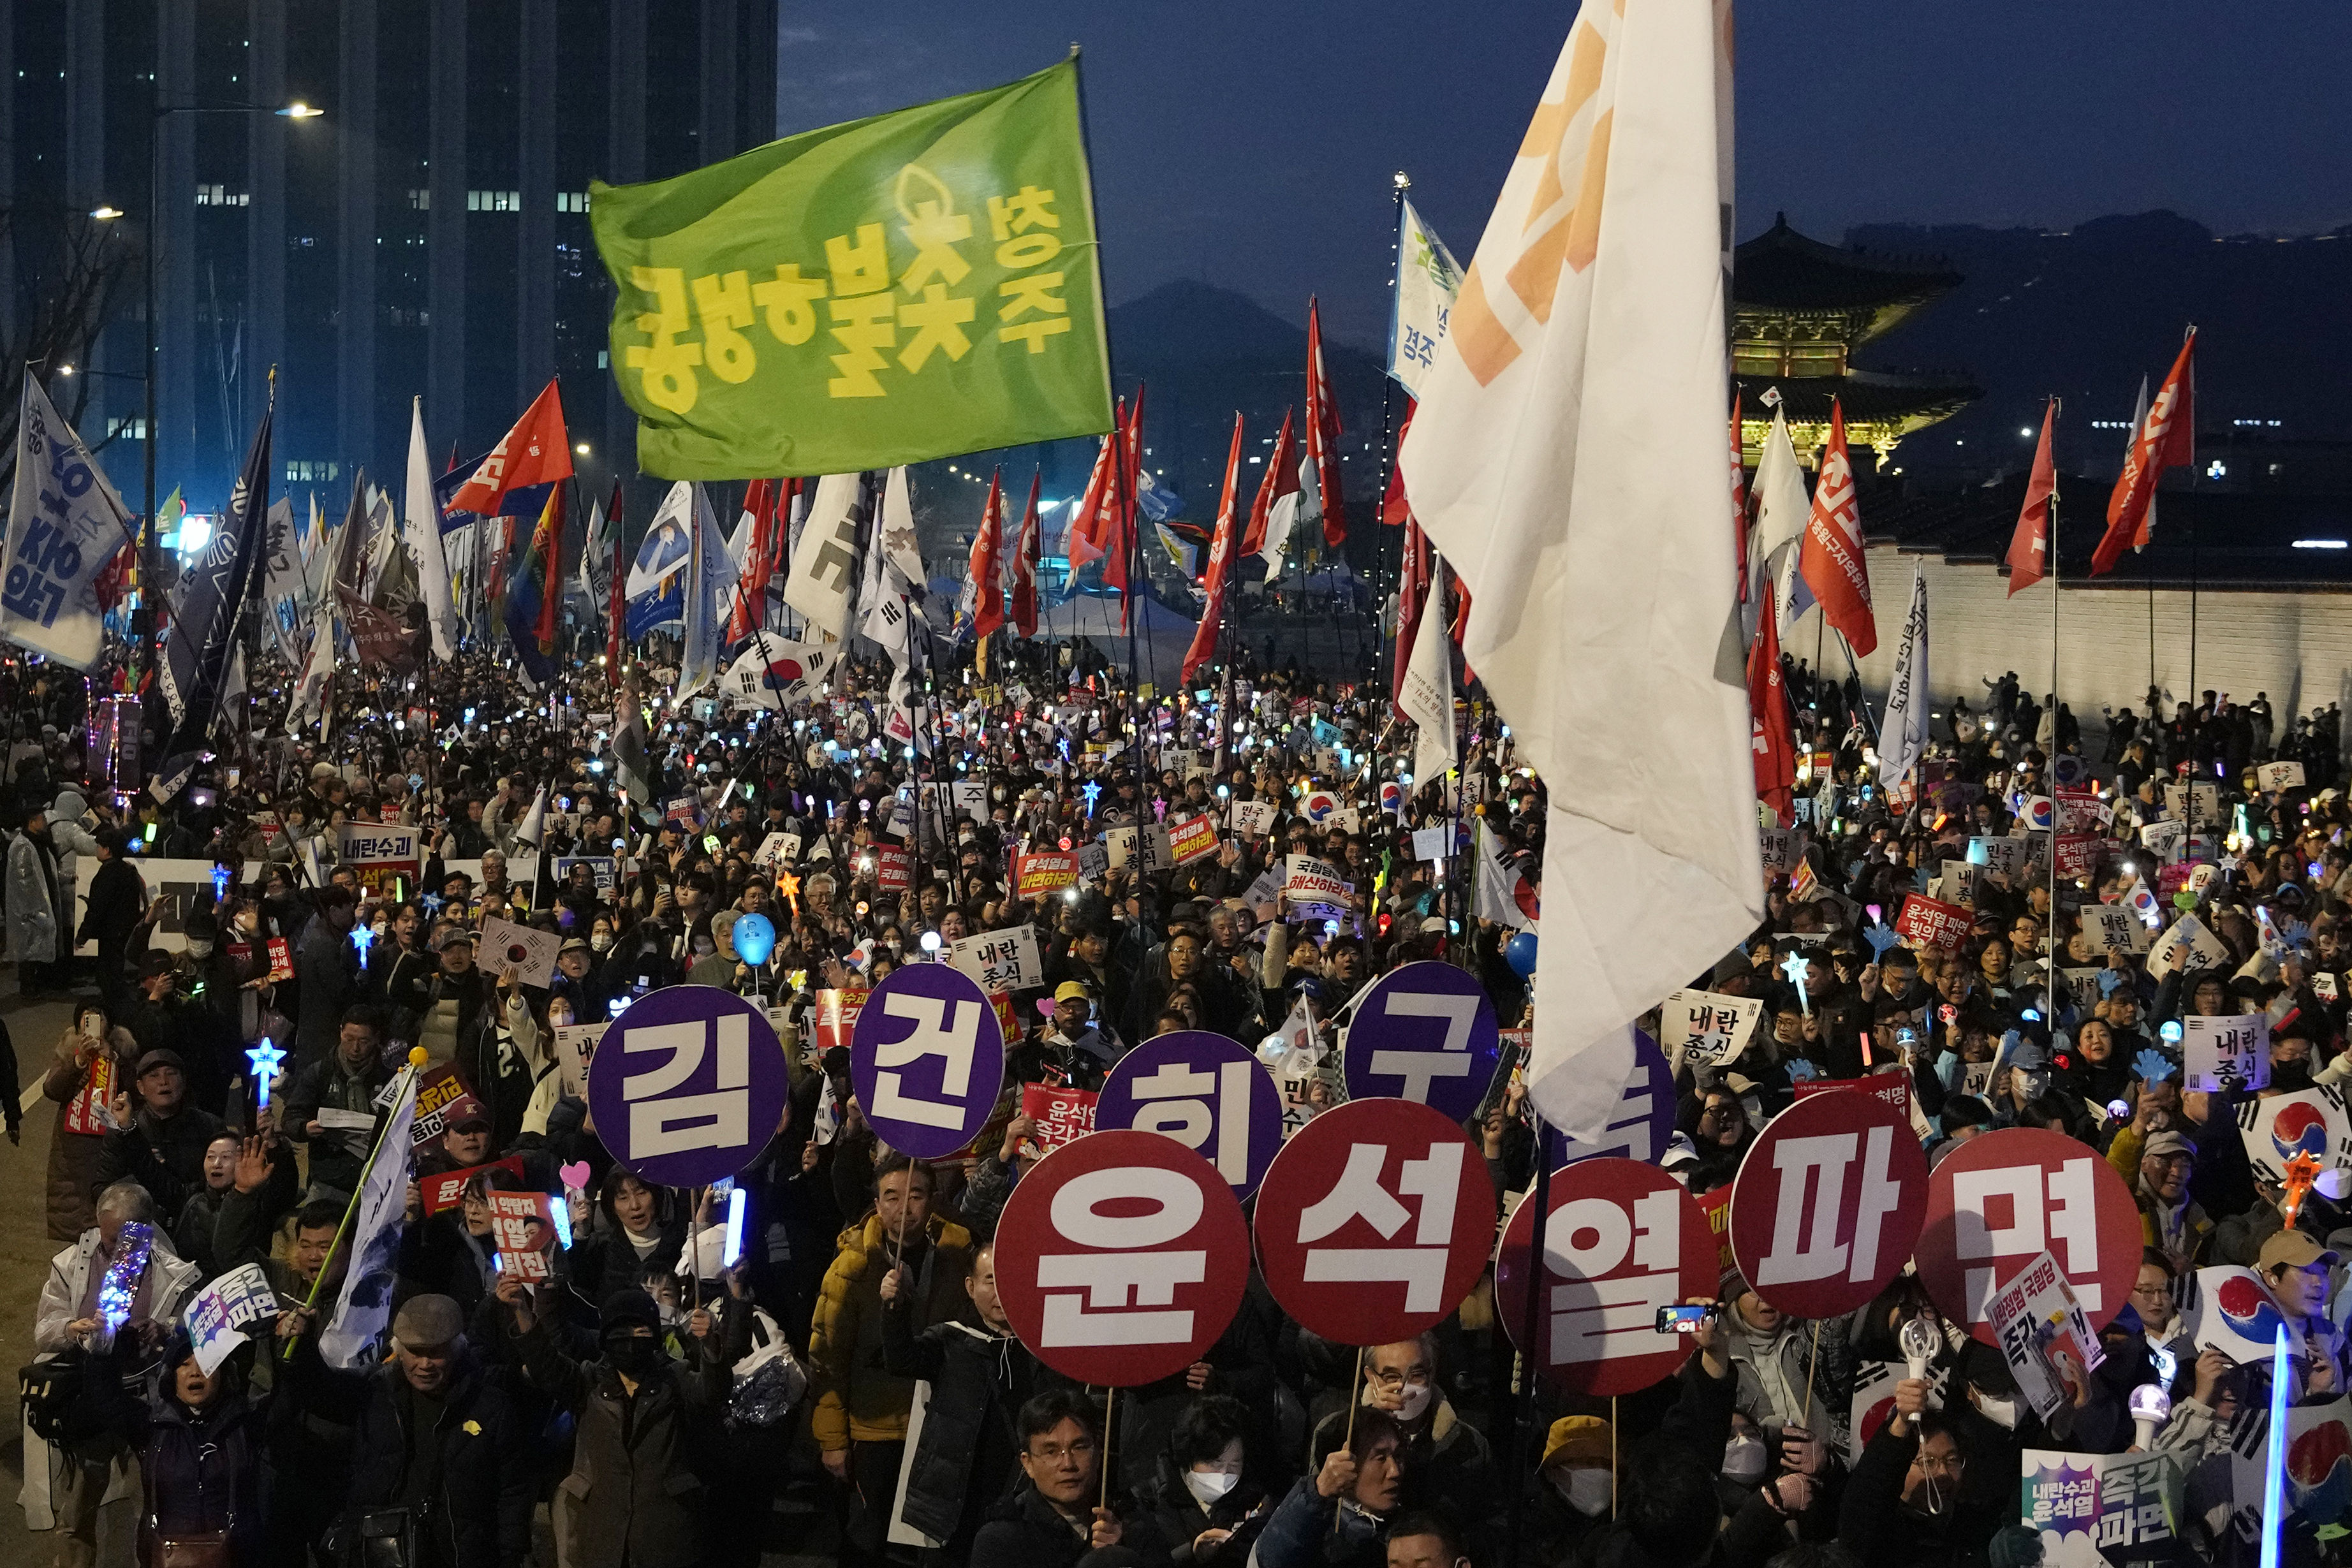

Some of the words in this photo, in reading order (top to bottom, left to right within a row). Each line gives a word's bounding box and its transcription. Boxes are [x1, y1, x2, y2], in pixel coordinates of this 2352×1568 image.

[1171, 755, 1188, 765] 민주
[1242, 805, 1265, 817] 민주
[1330, 817, 1347, 828] 민주
[344, 837, 411, 859] 내란수괴
[772, 839, 797, 853] 민주
[1761, 836, 1788, 853] 내란
[1987, 844, 2014, 860] 민주
[2058, 842, 2088, 856] 윤석열
[1024, 856, 1071, 874] 윤석열을
[1018, 871, 1078, 890] 파면하라!
[1907, 903, 1947, 929] 윤석열
[1946, 917, 1970, 936] 파면
[2101, 914, 2129, 932] 내란
[1909, 922, 1937, 941] 빛의
[1936, 929, 1959, 949] 혁명
[976, 939, 1019, 964] 내란
[1689, 1005, 1739, 1036] 내란
[1369, 992, 1480, 1104] 구
[2214, 1028, 2258, 1056] 내란
[871, 992, 981, 1131] 건
[623, 1013, 749, 1161] 김
[1034, 1118, 1074, 1143] 즉각
[1131, 1061, 1252, 1186] 희
[1756, 1126, 1900, 1286] 파
[1297, 1142, 1466, 1313] 석
[1953, 1157, 2103, 1323] 면
[501, 1250, 549, 1278] 퇴진
[1037, 1166, 1207, 1348] 윤
[1543, 1189, 1680, 1366] 열
[1991, 1289, 2025, 1331] 내란정범
[2023, 1261, 2056, 1307] 국힘당
[228, 1292, 280, 1330] 파면
[2032, 1477, 2096, 1501] 내란수괴
[2101, 1456, 2170, 1507] 즉각
[2032, 1497, 2094, 1523] 윤석열
[2098, 1507, 2173, 1550] 파면
